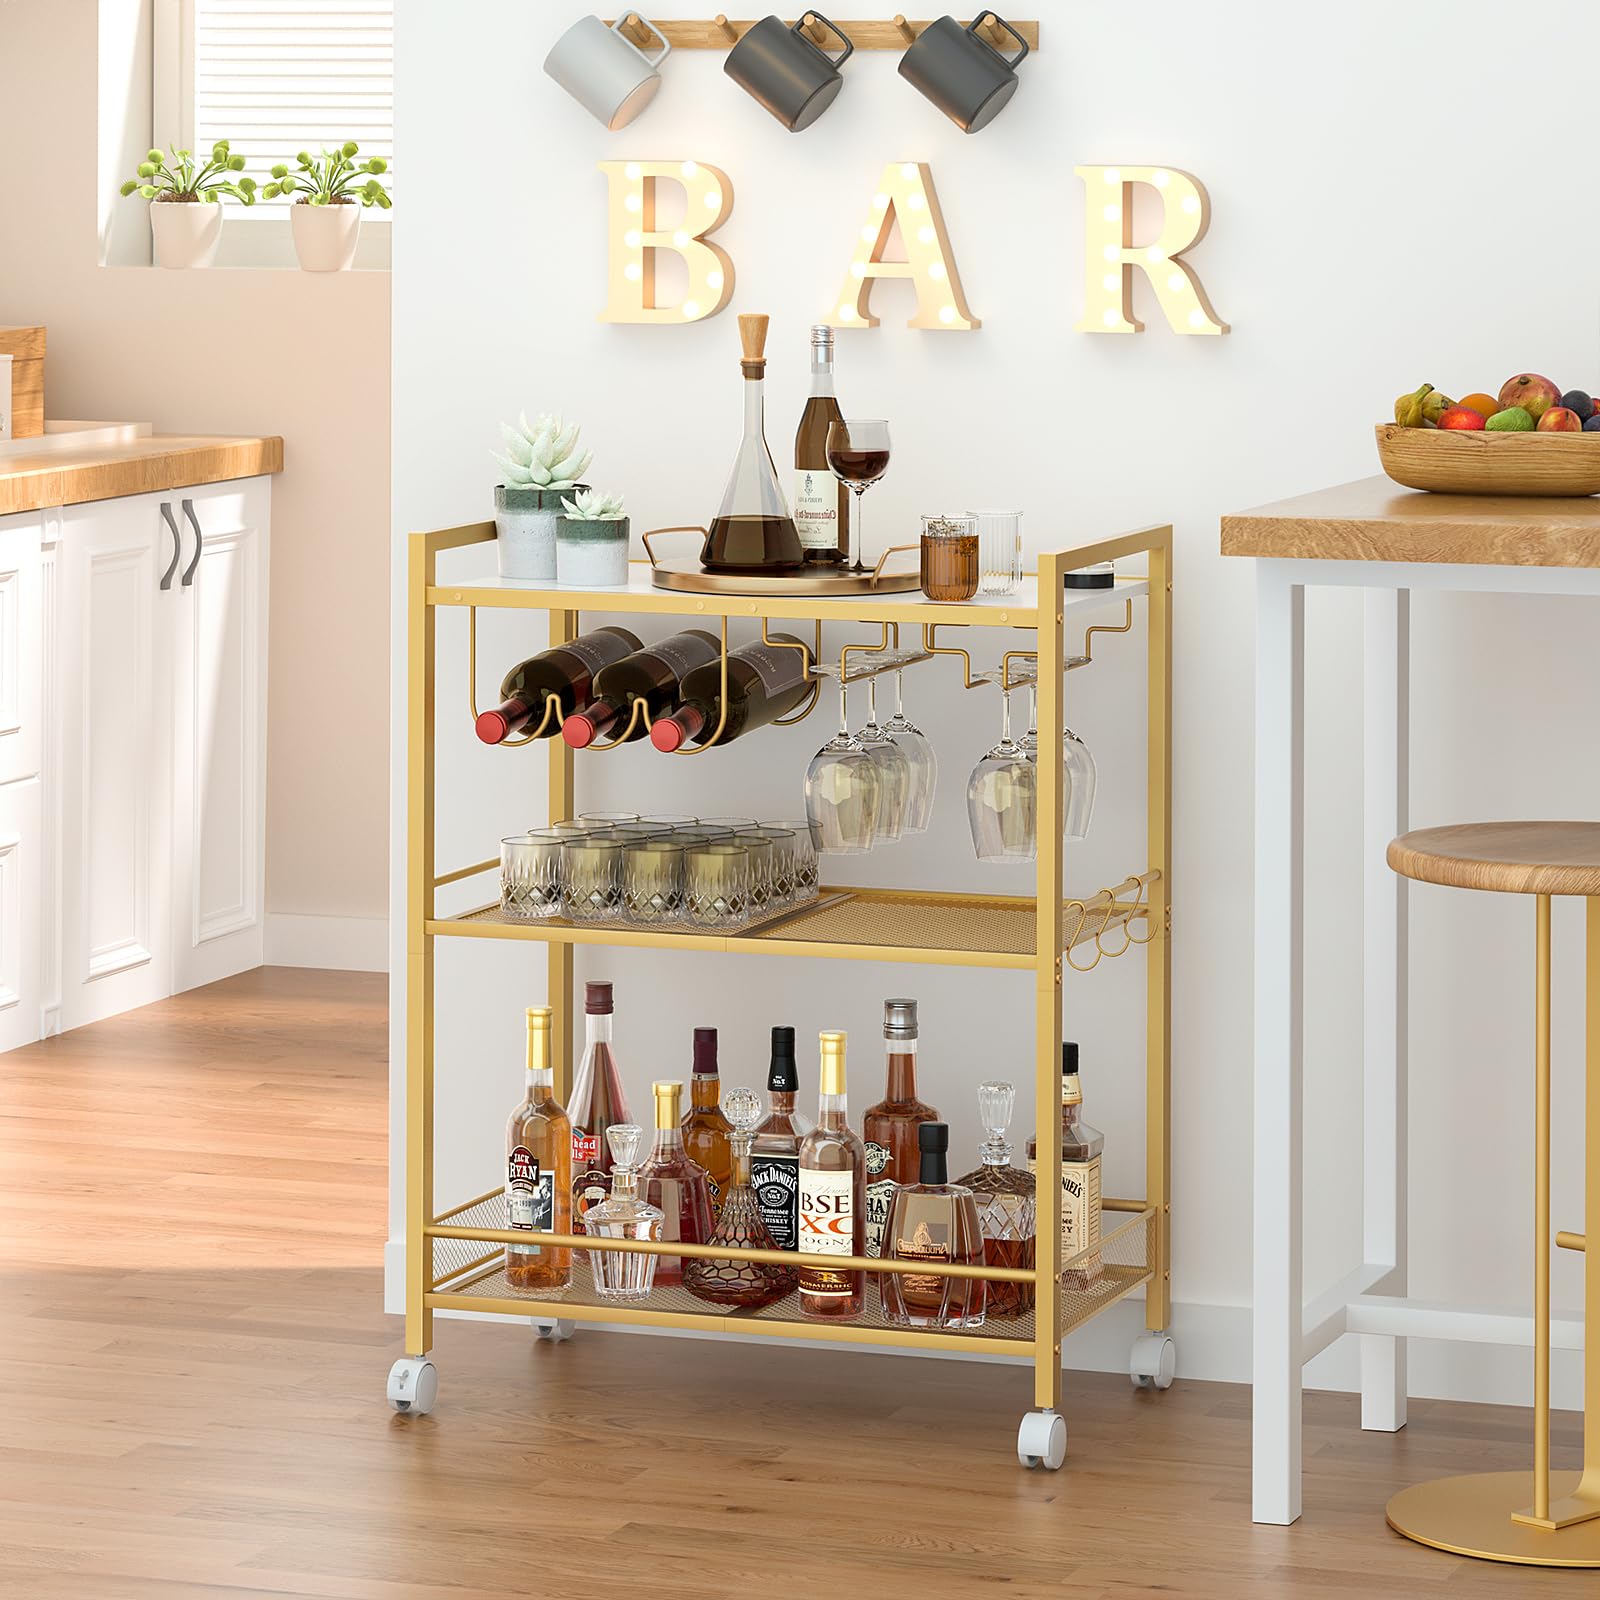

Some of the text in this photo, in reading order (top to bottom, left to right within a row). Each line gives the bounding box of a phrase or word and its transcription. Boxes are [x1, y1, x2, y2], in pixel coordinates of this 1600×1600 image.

[598, 159, 1232, 337] BAR
[573, 1138, 596, 1149] head
[514, 1153, 530, 1164] JACK
[509, 1162, 538, 1181] RYAN
[752, 1170, 770, 1190] JACK
[769, 1166, 798, 1192] DANIEL'S
[801, 1191, 850, 1214] BSE
